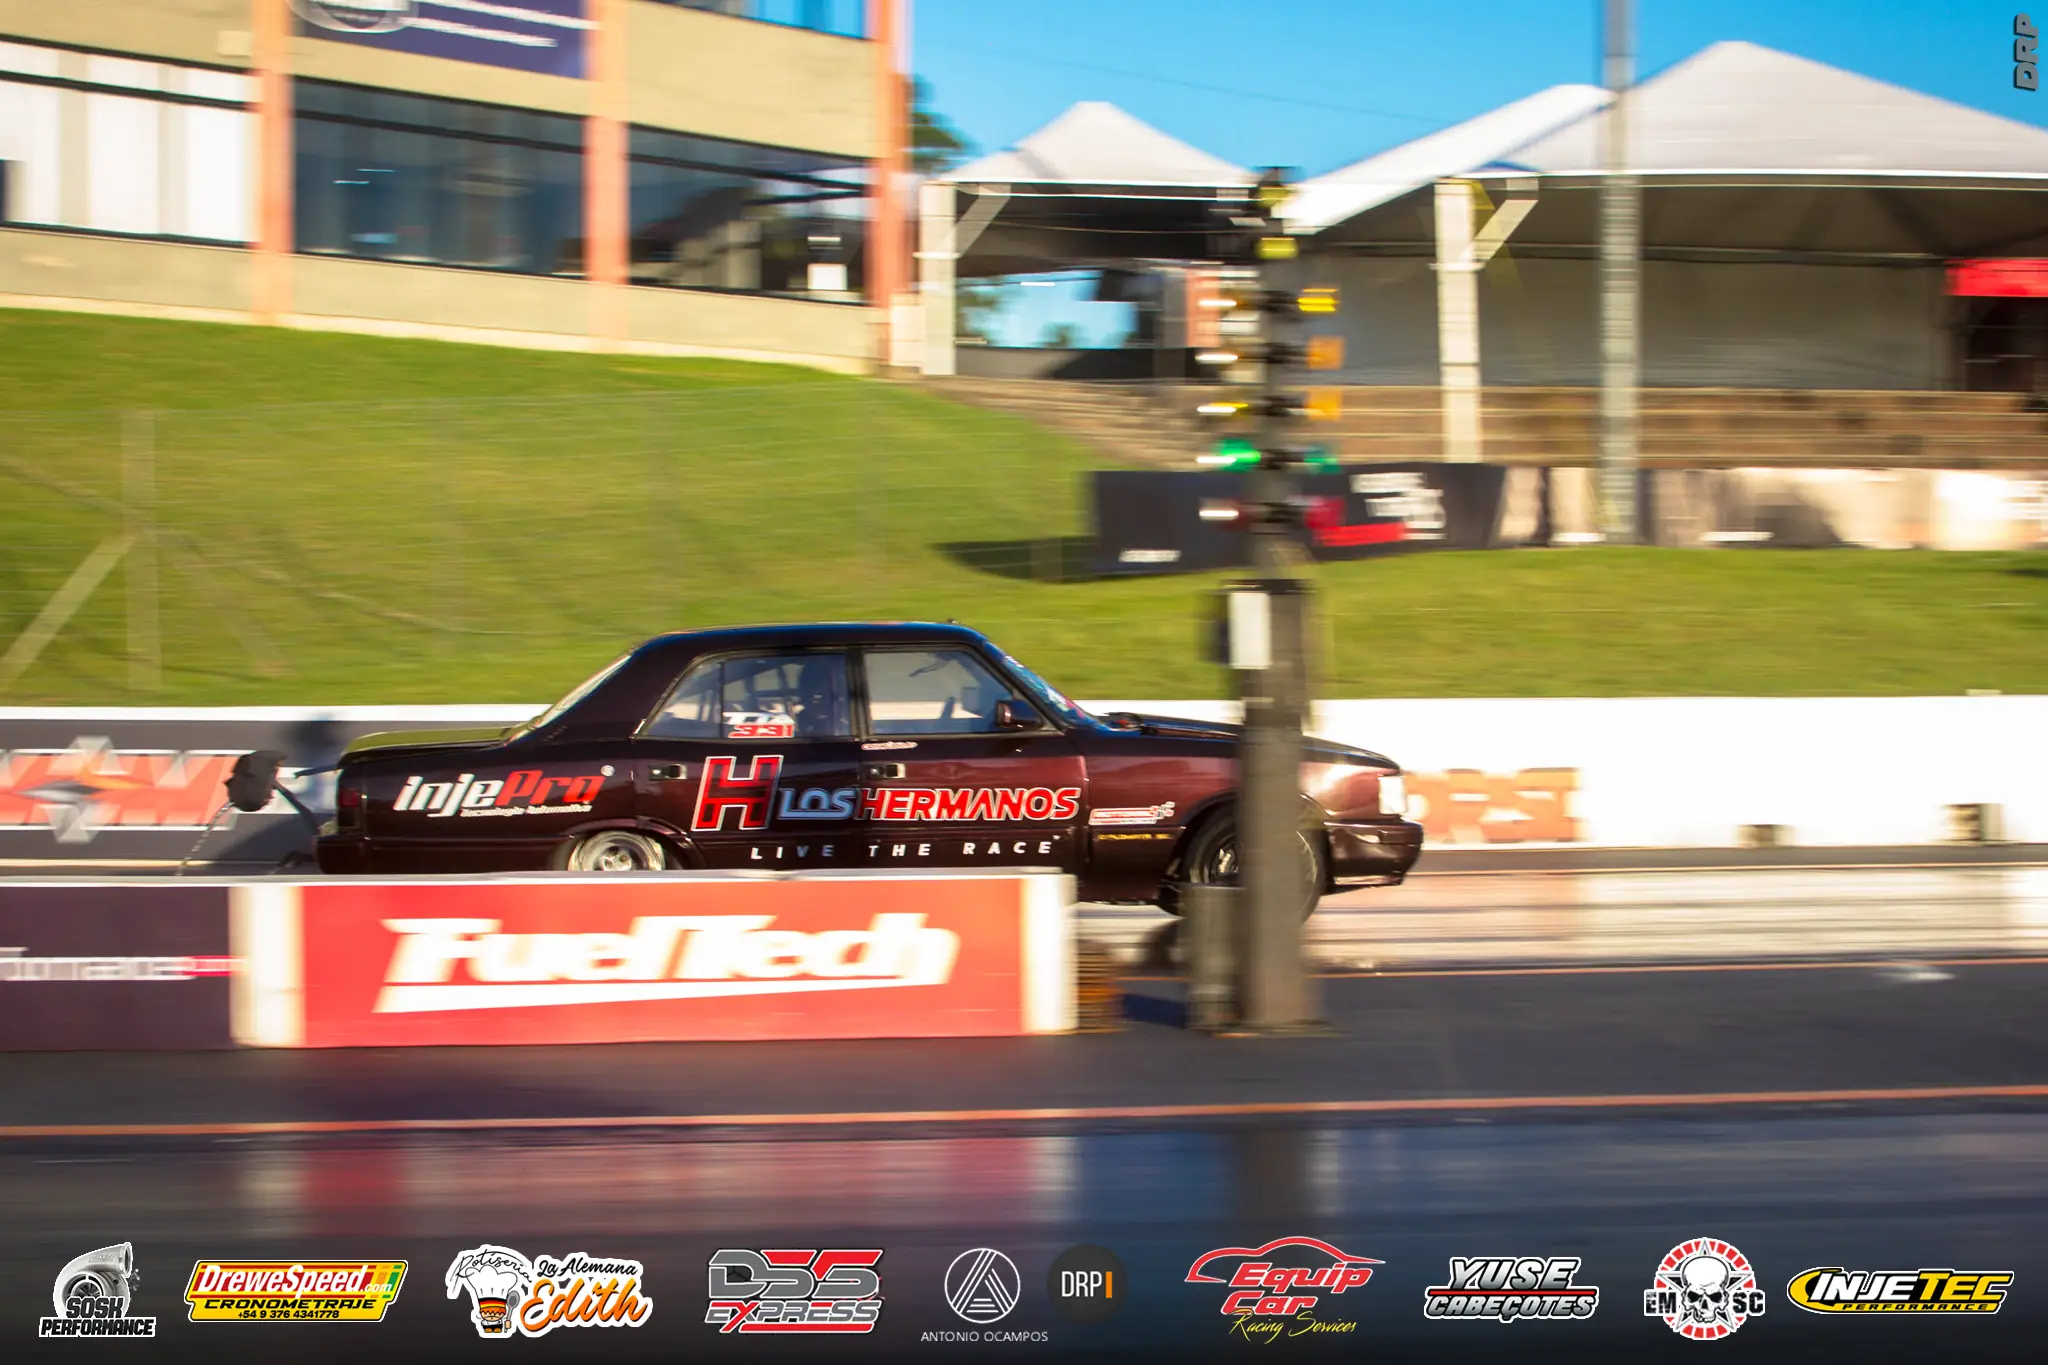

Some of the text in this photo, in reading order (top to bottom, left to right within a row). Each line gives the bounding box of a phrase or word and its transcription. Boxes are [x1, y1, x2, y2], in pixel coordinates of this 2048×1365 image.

[393, 770, 605, 817] injePro
[691, 755, 784, 831] H
[751, 841, 1052, 860] LIVE THE RACE
[379, 912, 961, 984] FuelTech
